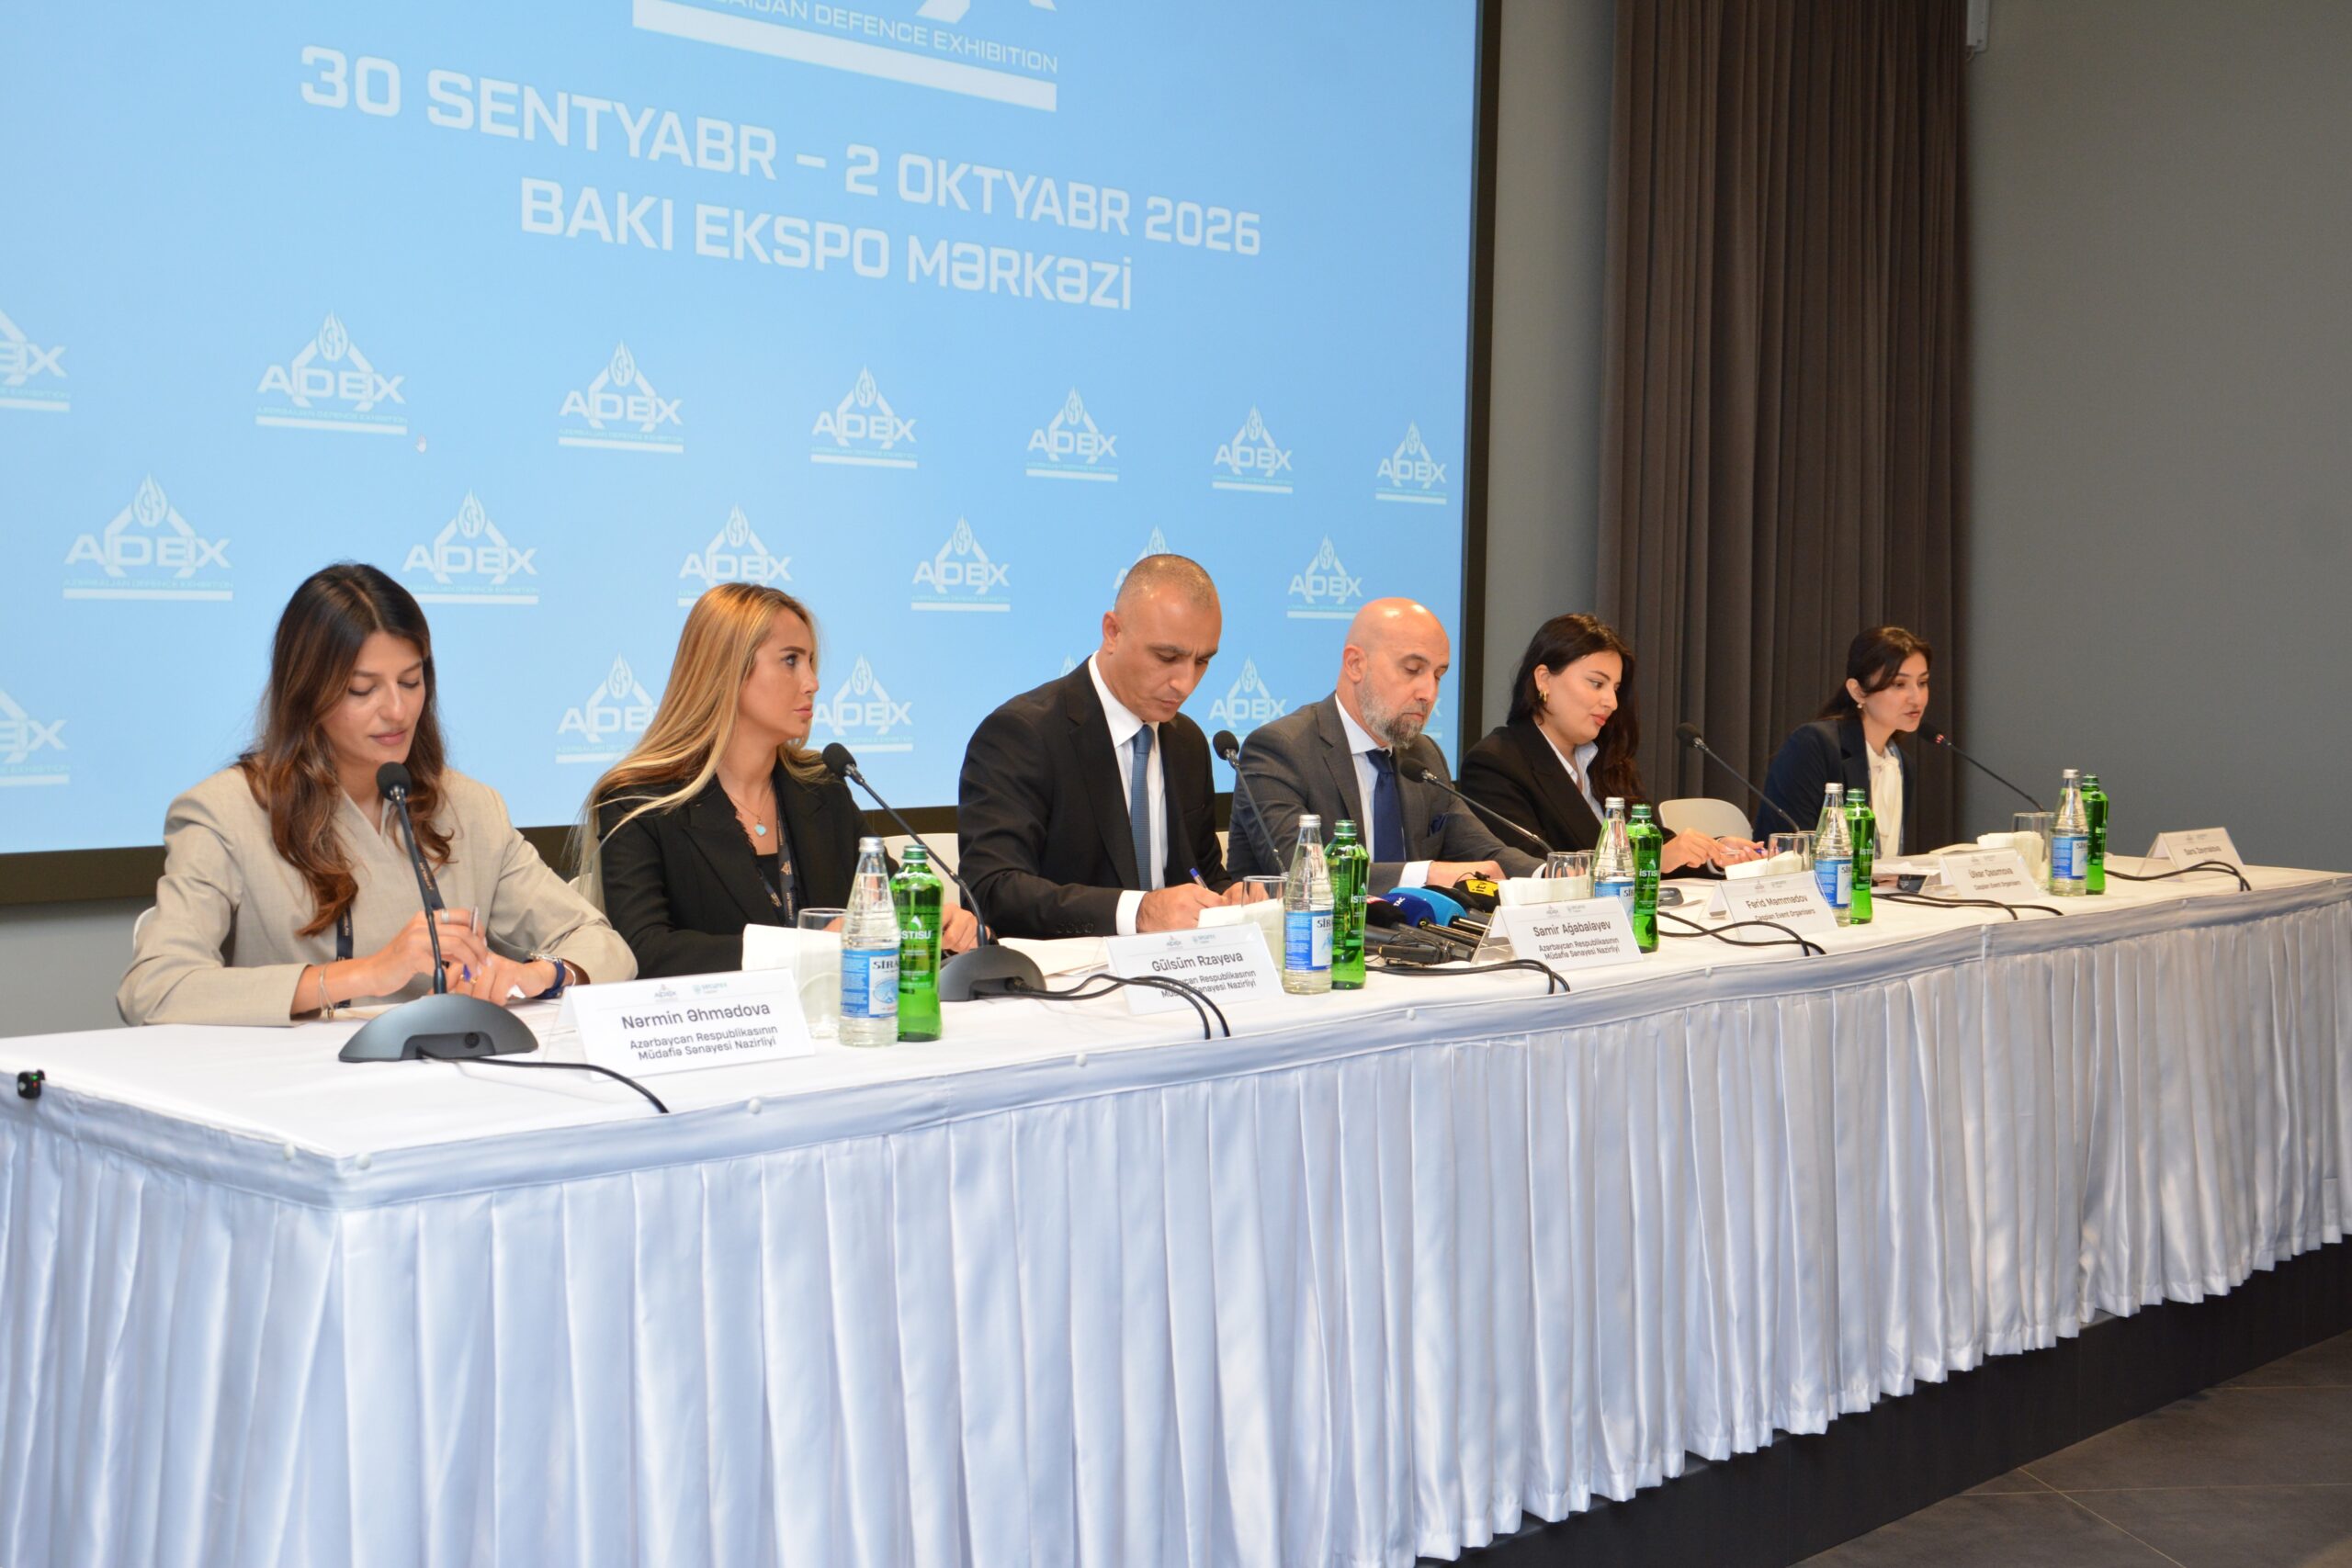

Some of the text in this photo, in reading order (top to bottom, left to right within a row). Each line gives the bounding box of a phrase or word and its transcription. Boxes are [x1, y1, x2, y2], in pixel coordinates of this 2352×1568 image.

[815, 4, 927, 47] DEFENCE
[933, 30, 1057, 73] EXHIBITION
[300, 45, 401, 118] 30
[427, 69, 777, 180] SENTYABR
[845, 143, 879, 197] 2
[898, 152, 1131, 236] OKTYABR
[1145, 196, 1261, 255] 2026
[521, 176, 673, 251] BAKI
[695, 203, 889, 279] EKSPO
[257, 365, 406, 404] ADEX
[558, 389, 683, 425] ADEX
[811, 412, 917, 443] ADEX
[1027, 428, 1117, 457] ADEX
[1213, 445, 1292, 471] ADEX
[1375, 457, 1447, 483] ADEX
[63, 533, 232, 568] ADEX
[402, 544, 537, 575] ADEX
[680, 553, 792, 581] ADEX
[911, 560, 1010, 586] ADEX
[1288, 574, 1363, 597] ADEX
[558, 705, 656, 734] ADE
[1532, 920, 1611, 937] Samir Ağabalayev
[1152, 952, 1244, 972] Gülsüm Rzayeva
[622, 1003, 771, 1030] Nərmin Əhmədova
[630, 1025, 778, 1050] Azərbaycan Respublikasının
[639, 1036, 777, 1061] Müdafiə Sənayesi Nazirliyi
